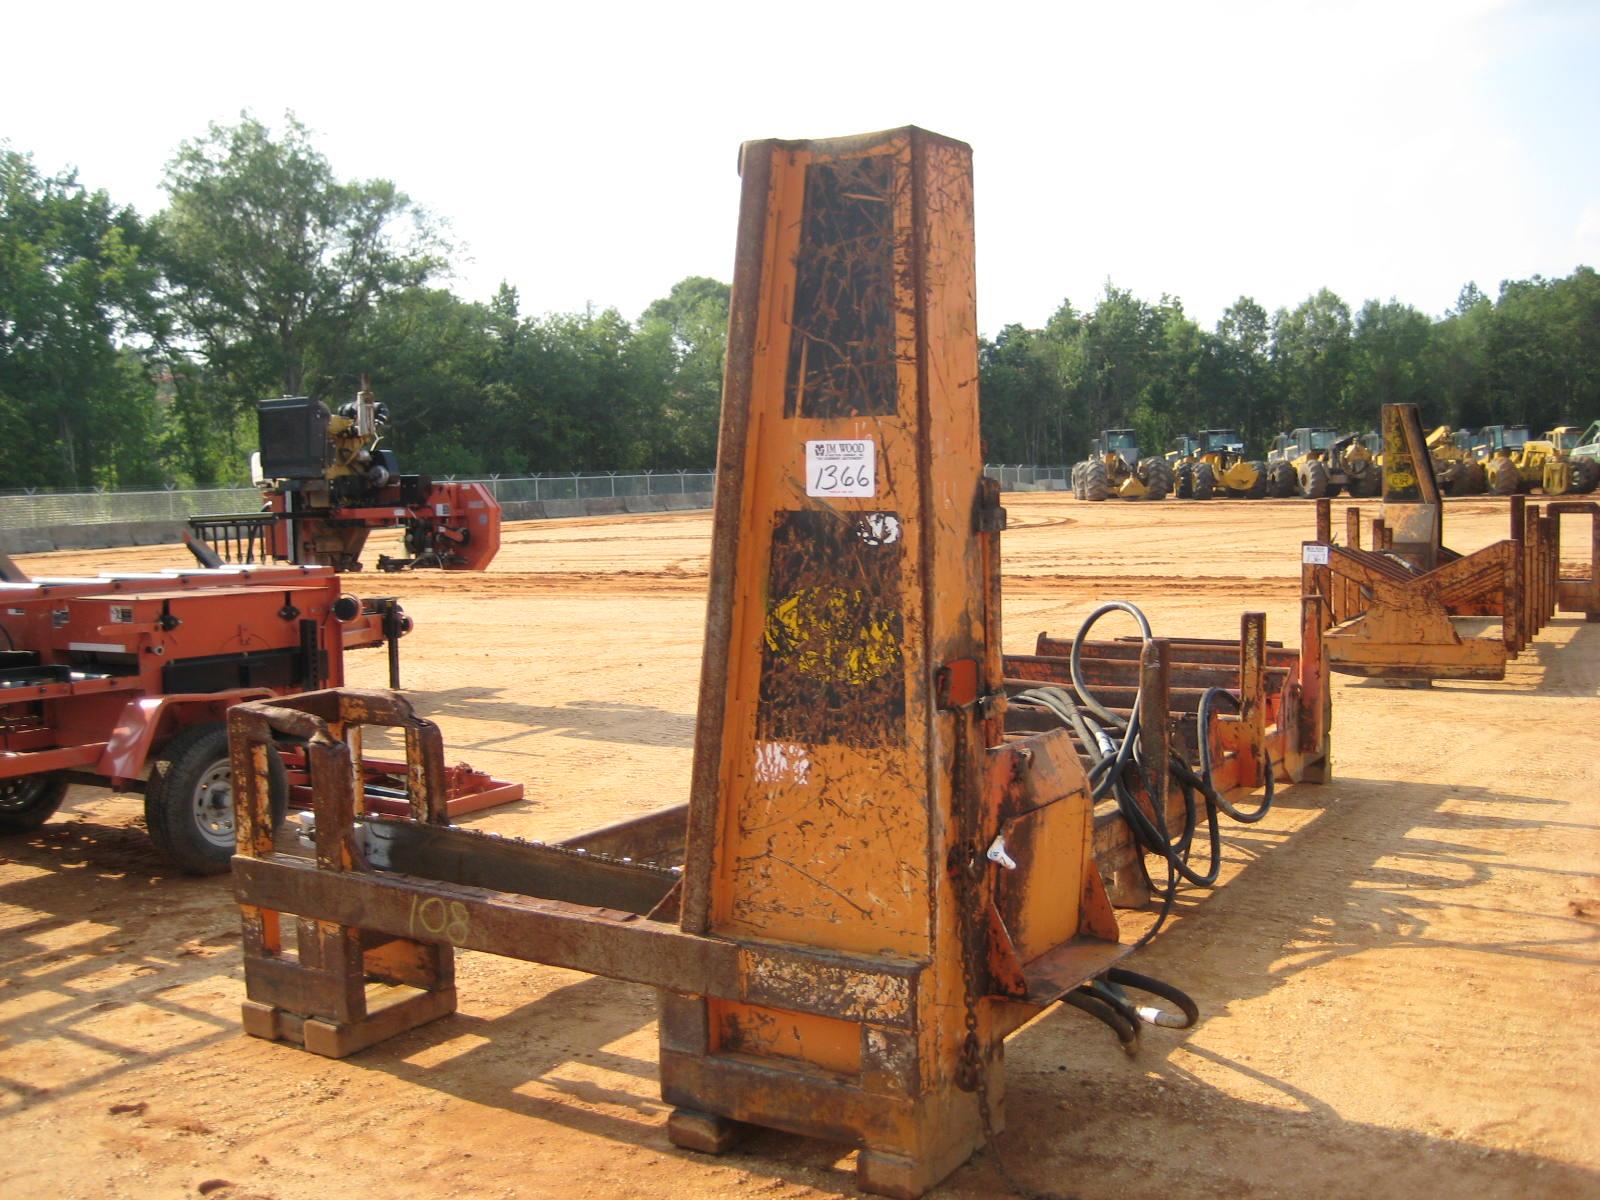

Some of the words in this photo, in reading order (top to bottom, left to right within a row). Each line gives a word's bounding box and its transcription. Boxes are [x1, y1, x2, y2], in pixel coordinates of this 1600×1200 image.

[839, 443, 865, 453] WOOD
[815, 464, 870, 490] 1366
[409, 893, 470, 945] 108
